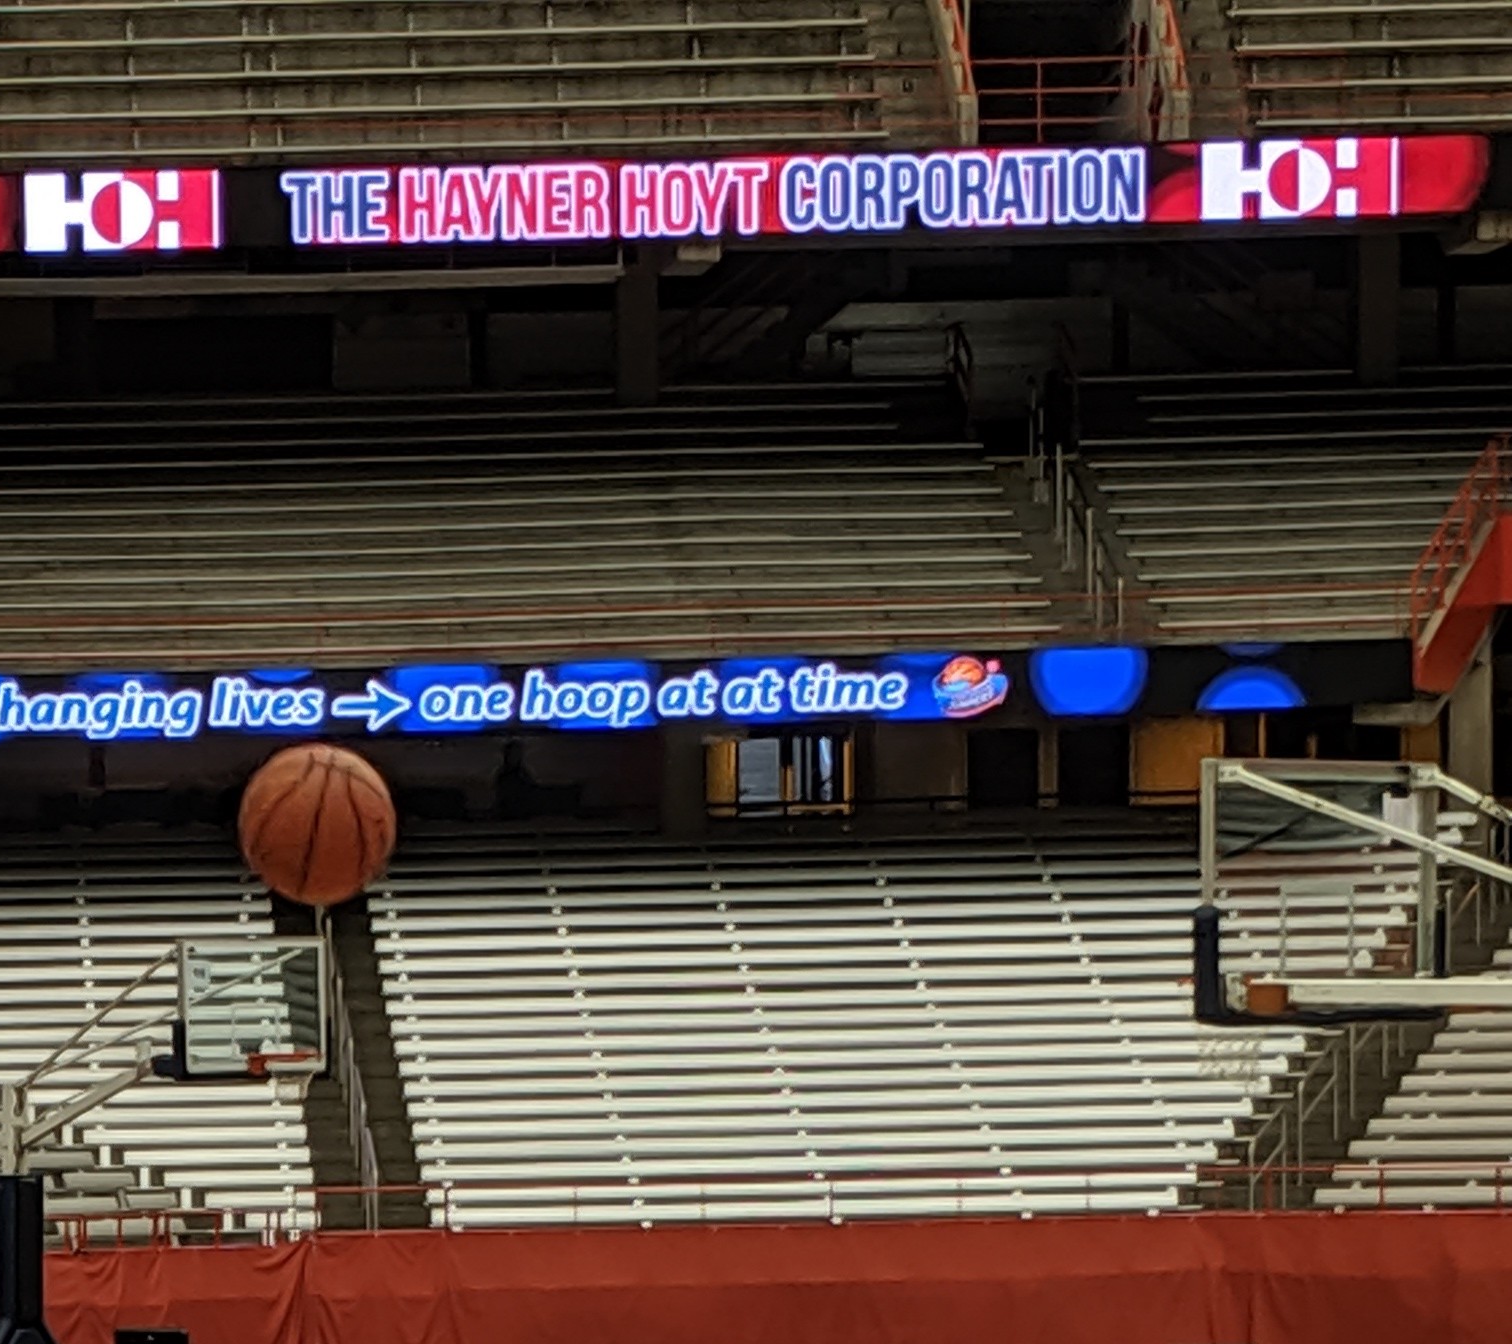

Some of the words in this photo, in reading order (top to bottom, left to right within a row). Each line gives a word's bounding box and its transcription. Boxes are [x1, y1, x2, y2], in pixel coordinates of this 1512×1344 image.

[281, 170, 388, 244] THE
[398, 163, 612, 242] HAYNER
[618, 156, 767, 238] HOYT
[779, 147, 1146, 231] CORPORATION
[208, 676, 324, 727] lives
[419, 684, 510, 722] one
[520, 668, 649, 728] hoop
[657, 672, 719, 720] at
[722, 670, 784, 717] at
[790, 662, 906, 714] time
